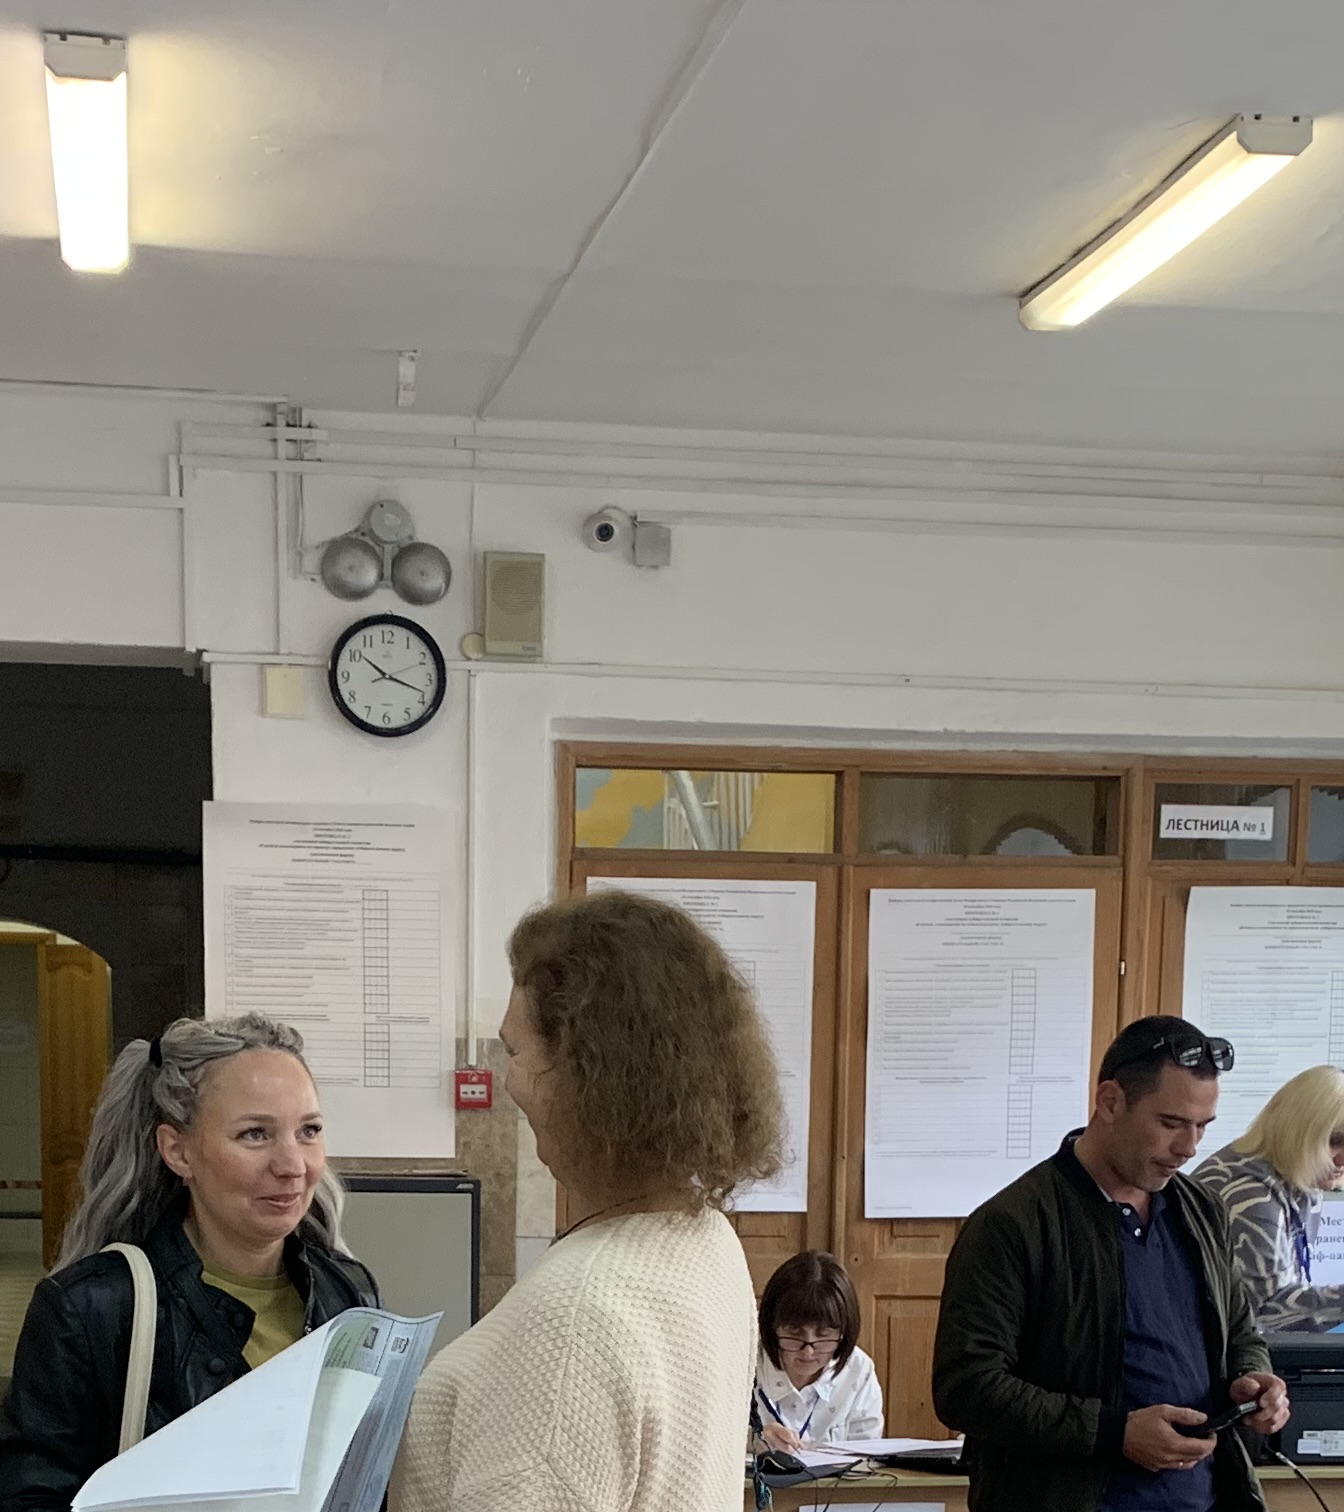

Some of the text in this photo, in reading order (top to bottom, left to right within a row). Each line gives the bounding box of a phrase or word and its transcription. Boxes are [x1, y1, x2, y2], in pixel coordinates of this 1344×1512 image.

[363, 634, 373, 648] 11
[381, 629, 394, 644] 12
[406, 636, 410, 649] 1
[349, 648, 362, 662] 10
[419, 651, 427, 665] 2
[341, 670, 350, 683] 9
[425, 672, 433, 686] 3
[348, 689, 356, 703] 8
[417, 690, 425, 706] 4
[364, 705, 372, 719] 7
[382, 711, 391, 725] 6
[403, 707, 411, 721] 5
[1165, 818, 1266, 835] ЛЕСТНИЦА № 1
